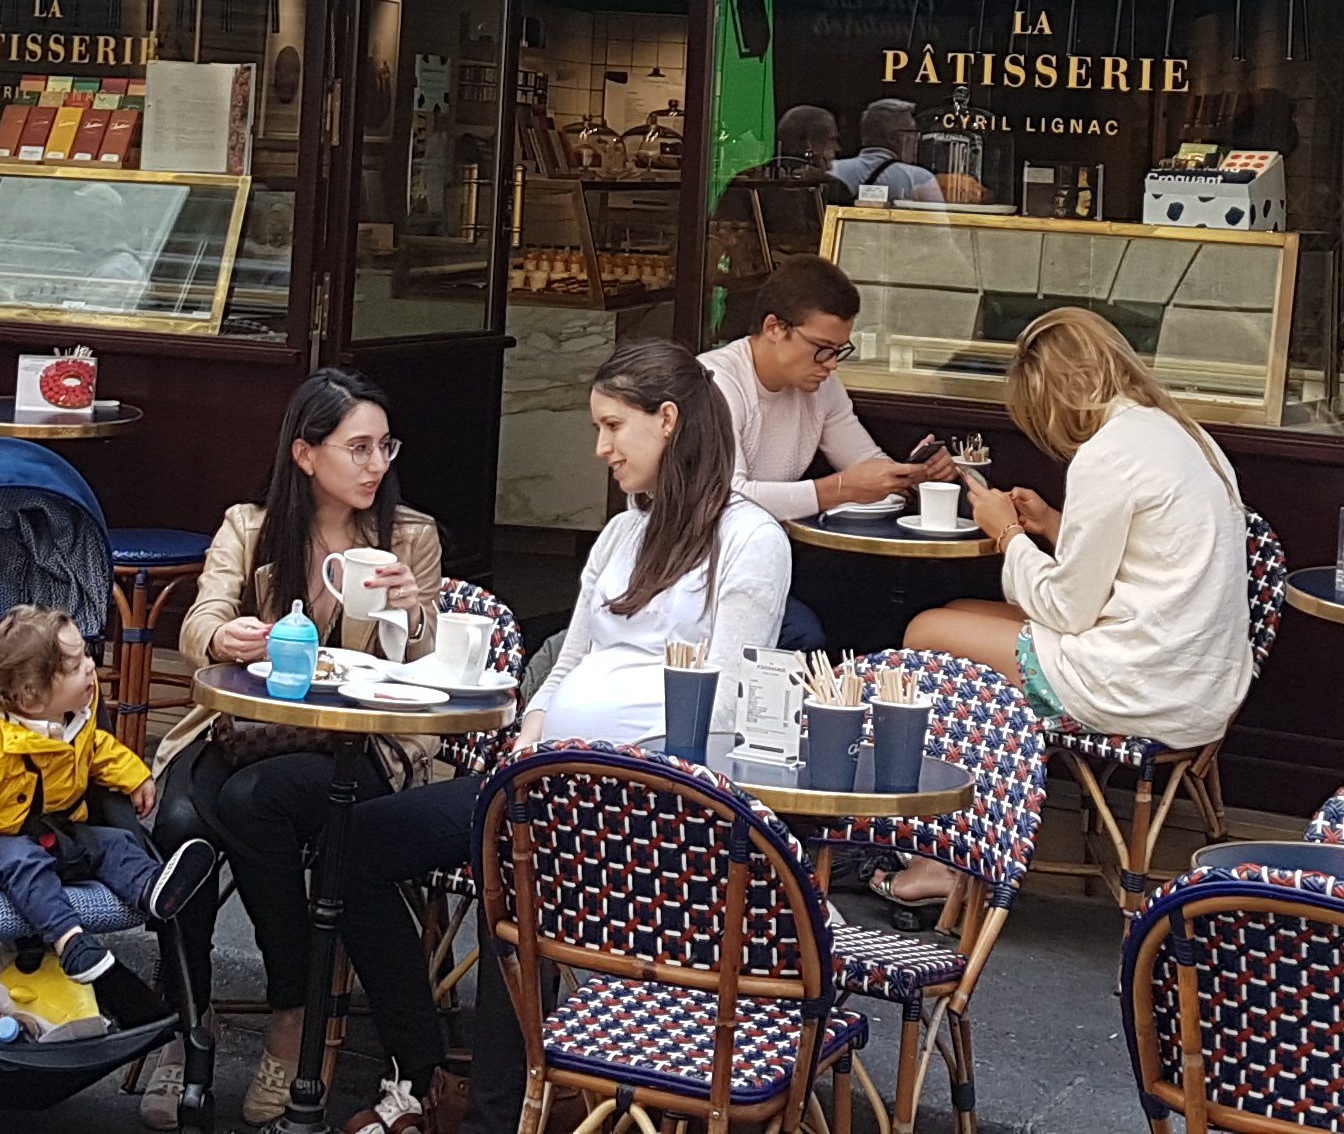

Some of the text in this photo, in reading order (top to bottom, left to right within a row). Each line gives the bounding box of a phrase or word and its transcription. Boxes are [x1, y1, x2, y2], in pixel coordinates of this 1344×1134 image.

[1013, 11, 1053, 35] LA
[881, 44, 1190, 92] PÂTISSERIE
[942, 113, 1119, 136] CYRIL LIGNAC
